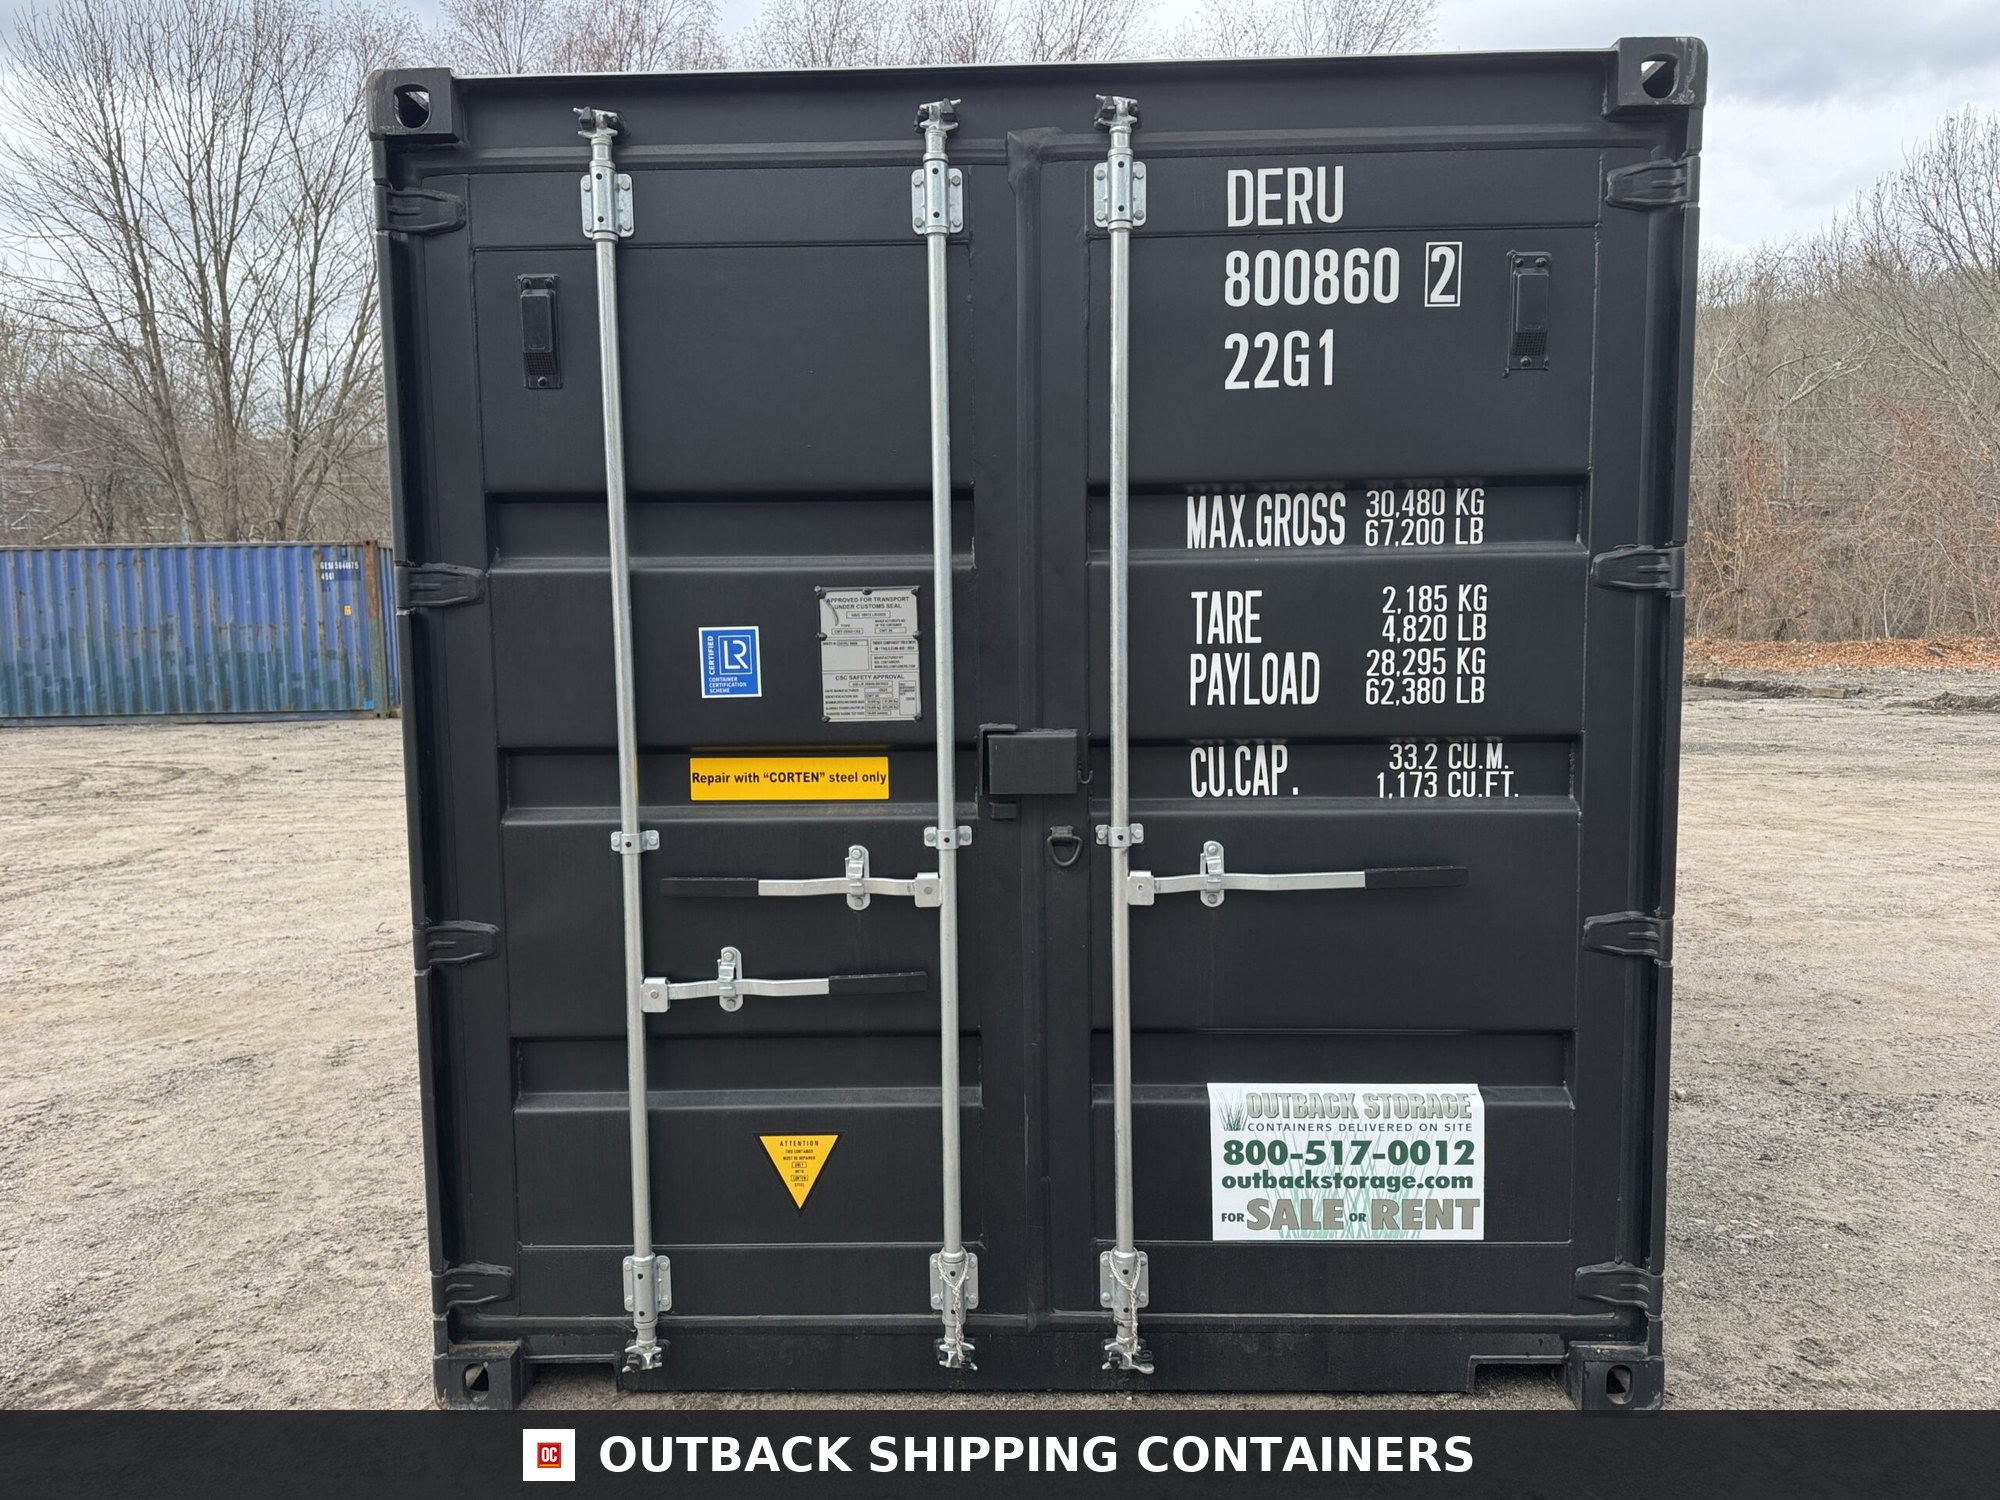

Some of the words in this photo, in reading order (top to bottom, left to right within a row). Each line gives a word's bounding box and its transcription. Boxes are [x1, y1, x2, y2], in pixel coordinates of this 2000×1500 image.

[1227, 165, 1344, 227] DERU
[1224, 247, 1400, 307] 800860
[1430, 246, 1456, 303] 2
[1224, 328, 1334, 390] 22G1
[1366, 488, 1446, 519] 30,480
[1455, 488, 1485, 516] KG
[1187, 491, 1346, 549] MAX.GROSS
[1365, 517, 1445, 548] 67,200
[1455, 516, 1484, 545] LB
[1382, 584, 1448, 614] 2,185
[1458, 583, 1488, 612] KG
[1191, 590, 1263, 645] TARE
[1381, 613, 1447, 644] 4,820
[1457, 613, 1487, 642] LB
[707, 635, 716, 675] CERTIFIED
[723, 640, 750, 669] LR
[1366, 647, 1446, 678] 28,295
[1456, 646, 1486, 675] KG
[1190, 651, 1320, 706] PAYLOAD
[1365, 676, 1446, 707] 62,380
[1456, 676, 1485, 704] LB
[1388, 743, 1438, 770] 33.2
[1448, 743, 1509, 770] CU.M.
[692, 772, 730, 786] Repair
[734, 772, 760, 783] with
[829, 771, 858, 783] steel
[862, 771, 887, 785] only
[1376, 771, 1438, 799] 1,173
[1447, 770, 1519, 798] CU.FT.
[1245, 1092, 1359, 1120] OUTBACK
[1362, 1092, 1473, 1120] STORAGE
[1247, 1123, 1333, 1132] CONTAINERS
[1338, 1123, 1413, 1132] DELIVERED
[1419, 1123, 1438, 1132] ON
[1444, 1123, 1473, 1132] SITE
[1223, 1139, 1475, 1166] 800-517-0012
[1221, 1170, 1473, 1193] outbackstorage.com
[1221, 1212, 1245, 1222] FOR
[1246, 1198, 1345, 1230] SALE
[1349, 1212, 1367, 1222] OR
[1371, 1198, 1481, 1230] RENT
